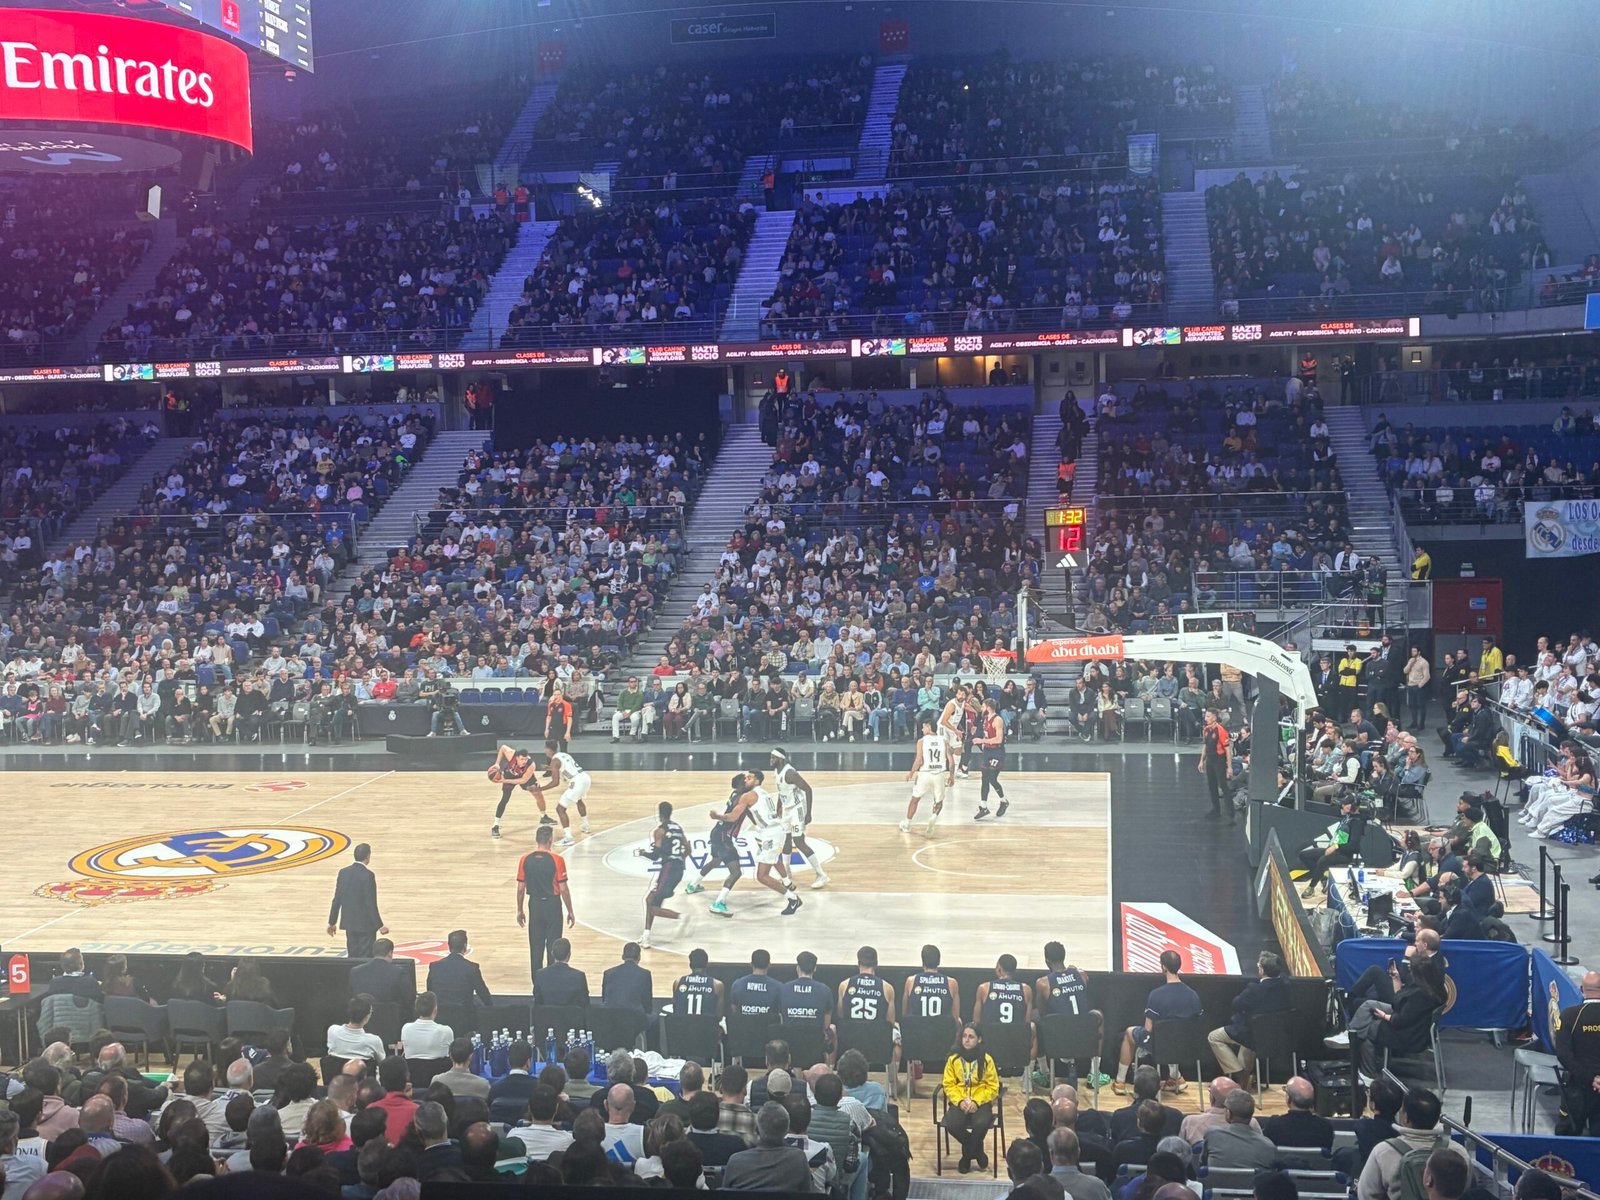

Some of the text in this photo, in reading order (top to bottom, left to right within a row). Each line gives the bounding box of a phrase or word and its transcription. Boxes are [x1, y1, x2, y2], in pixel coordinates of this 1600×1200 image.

[688, 22, 722, 34] caser
[0, 42, 214, 108] Emirates
[1232, 332, 1262, 340] SOCIO
[1059, 510, 1082, 523] 1:32
[1569, 502, 1600, 520] LOS O
[1060, 527, 1080, 550] 12
[1572, 534, 1598, 550] desde
[1051, 643, 1119, 657] abu dhabi
[1269, 655, 1294, 674] SPALDING
[929, 749, 940, 763] 14
[12, 964, 26, 983] 5
[794, 985, 812, 993] VILLAR
[687, 994, 702, 1014] 11
[851, 997, 877, 1020] 25
[921, 996, 941, 1016] 10
[1000, 1002, 1013, 1023] 9
[1069, 995, 1079, 1015] 1
[15, 1148, 39, 1156] ONIA
